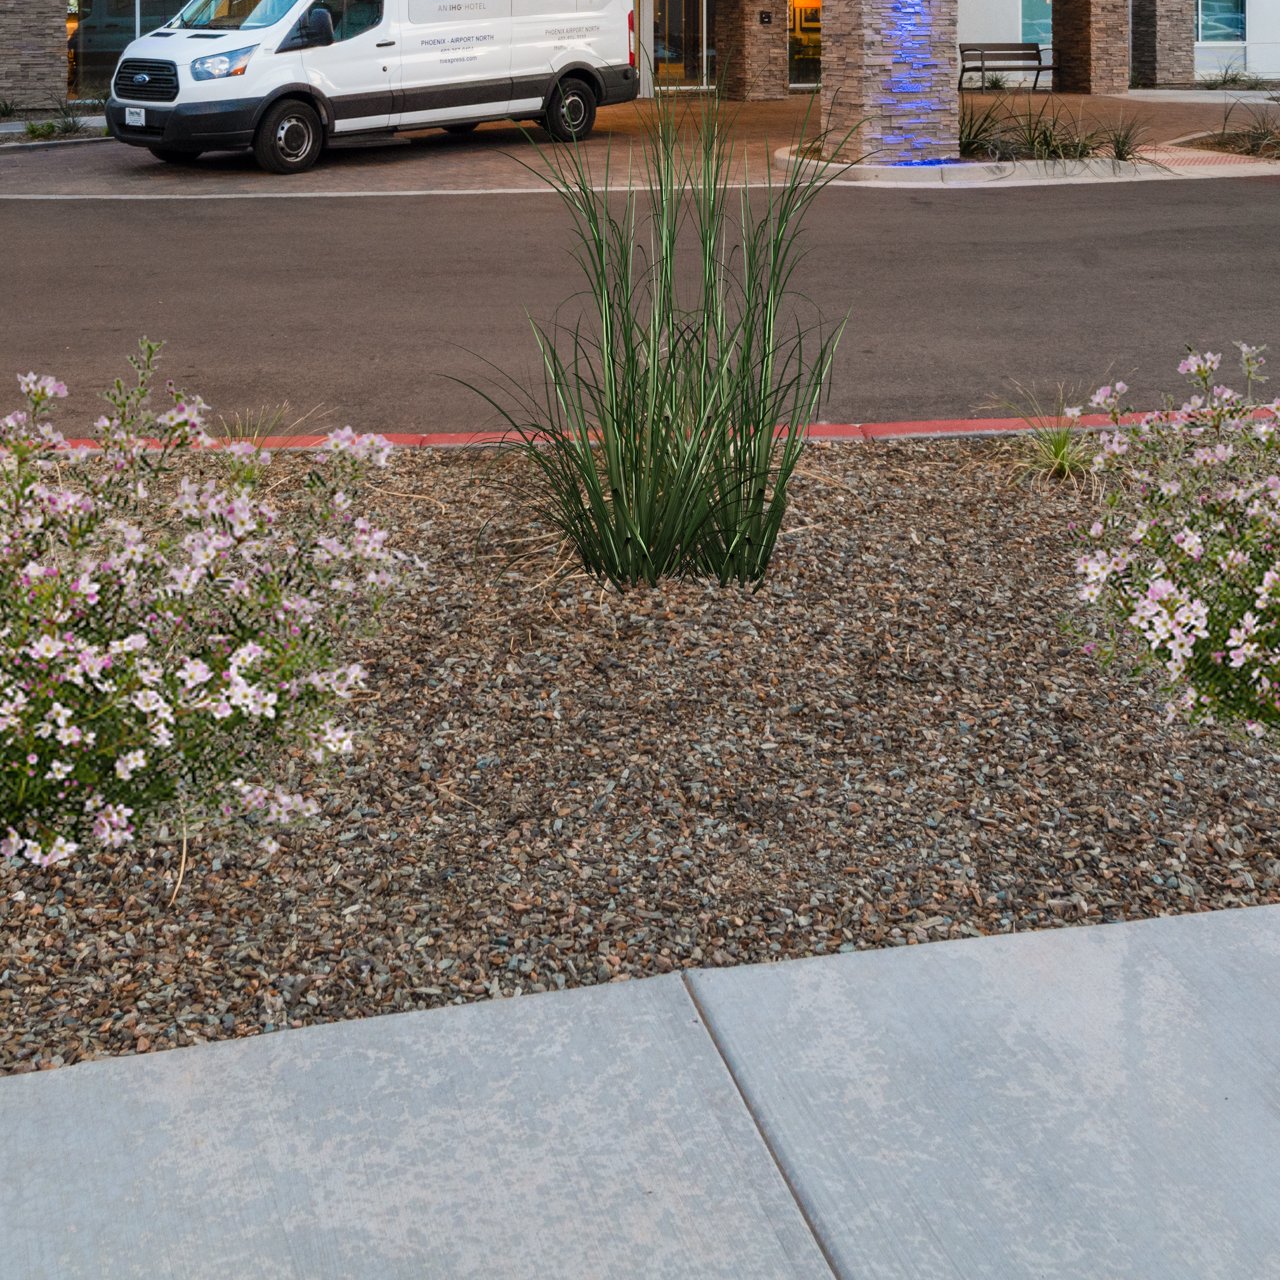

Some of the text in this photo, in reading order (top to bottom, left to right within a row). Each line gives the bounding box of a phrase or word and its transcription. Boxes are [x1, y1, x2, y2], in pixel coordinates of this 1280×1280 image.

[438, 2, 487, 12] AN IHG HOTEL
[420, 38, 447, 46] PHOENIX
[450, 35, 474, 44] AIRPORT
[475, 34, 495, 42] NORTH
